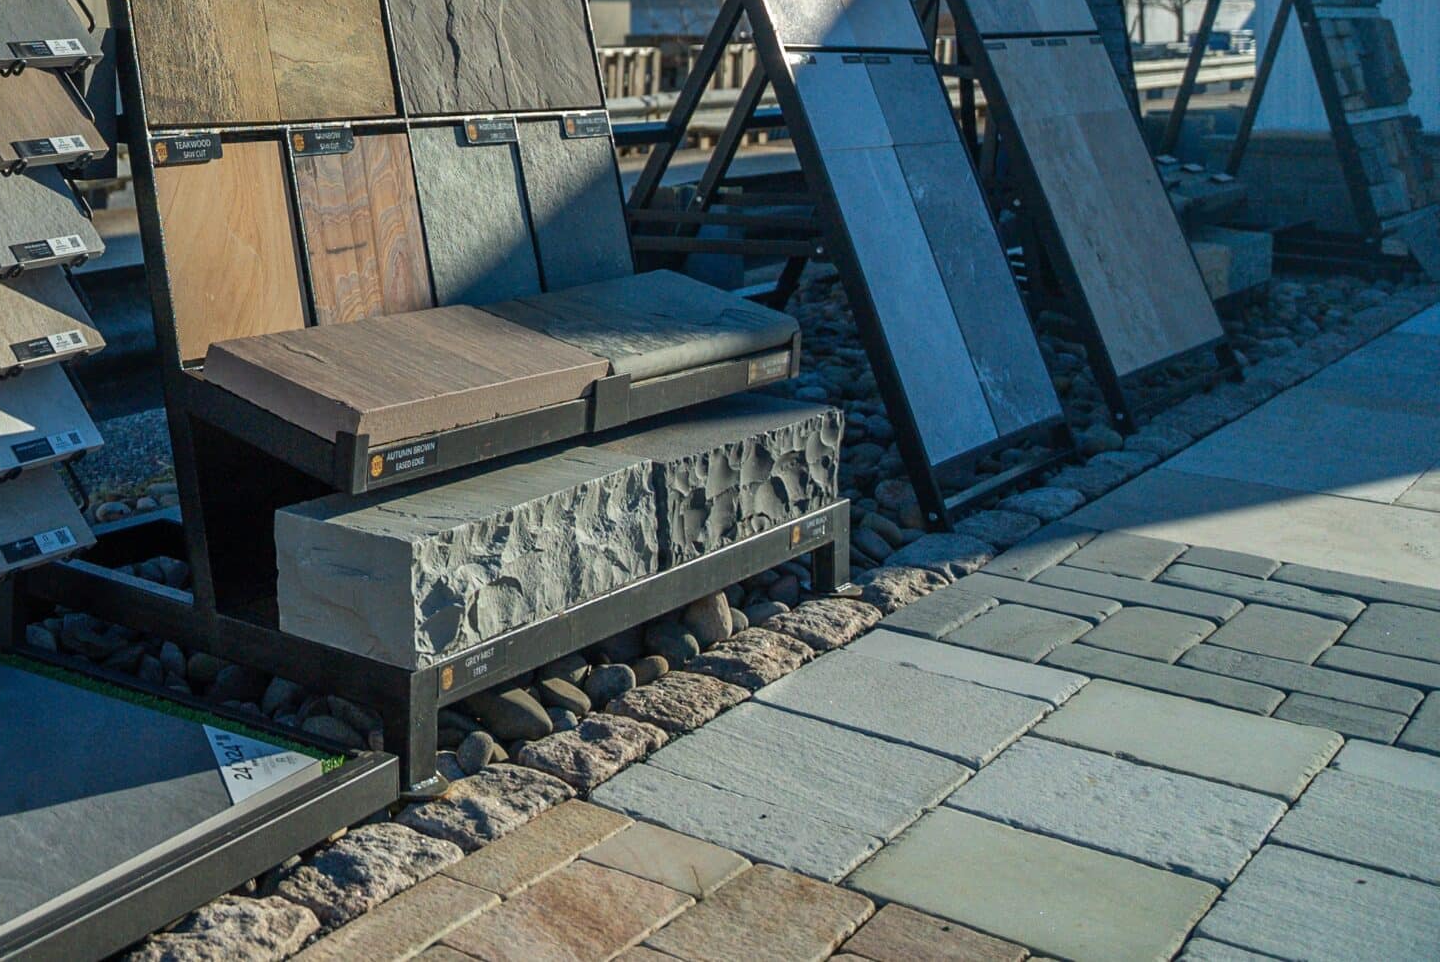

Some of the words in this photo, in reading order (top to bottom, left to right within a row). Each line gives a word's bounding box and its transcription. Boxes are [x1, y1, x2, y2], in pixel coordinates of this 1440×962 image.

[175, 139, 211, 150] TEAKWOOD
[386, 446, 412, 462] AUTUMN
[413, 442, 436, 455] BROWN
